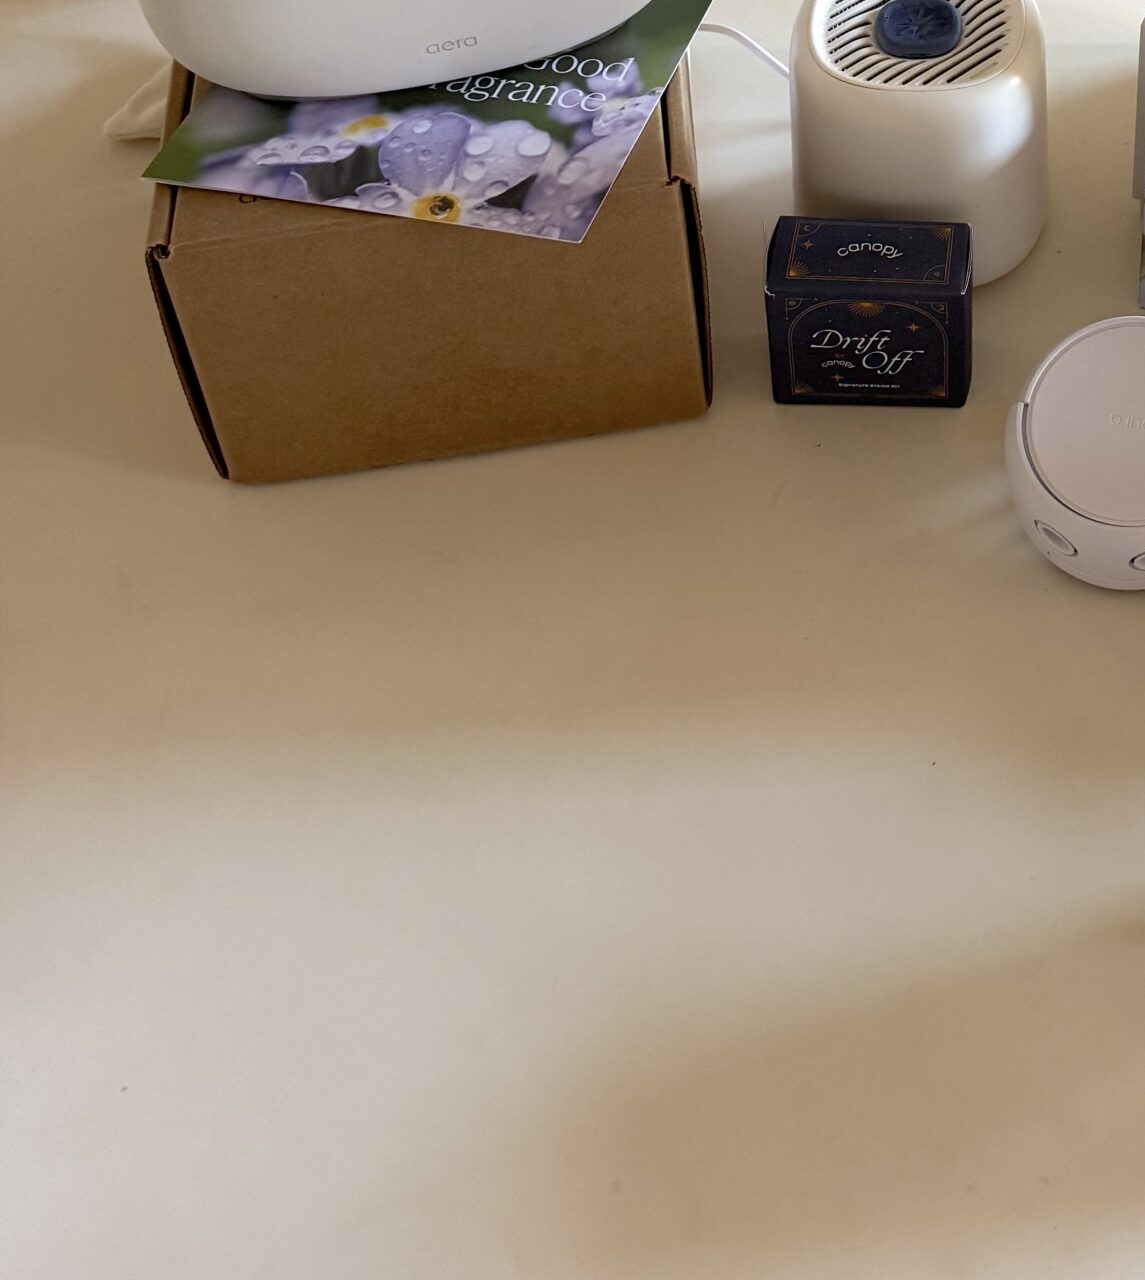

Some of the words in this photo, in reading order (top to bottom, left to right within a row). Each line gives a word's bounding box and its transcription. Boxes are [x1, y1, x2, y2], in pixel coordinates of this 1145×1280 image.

[426, 36, 478, 55] aera
[428, 75, 607, 112] agrance
[837, 242, 903, 259] canopy
[810, 329, 893, 354] Drift
[821, 360, 857, 369] canopy
[862, 350, 925, 375] Off
